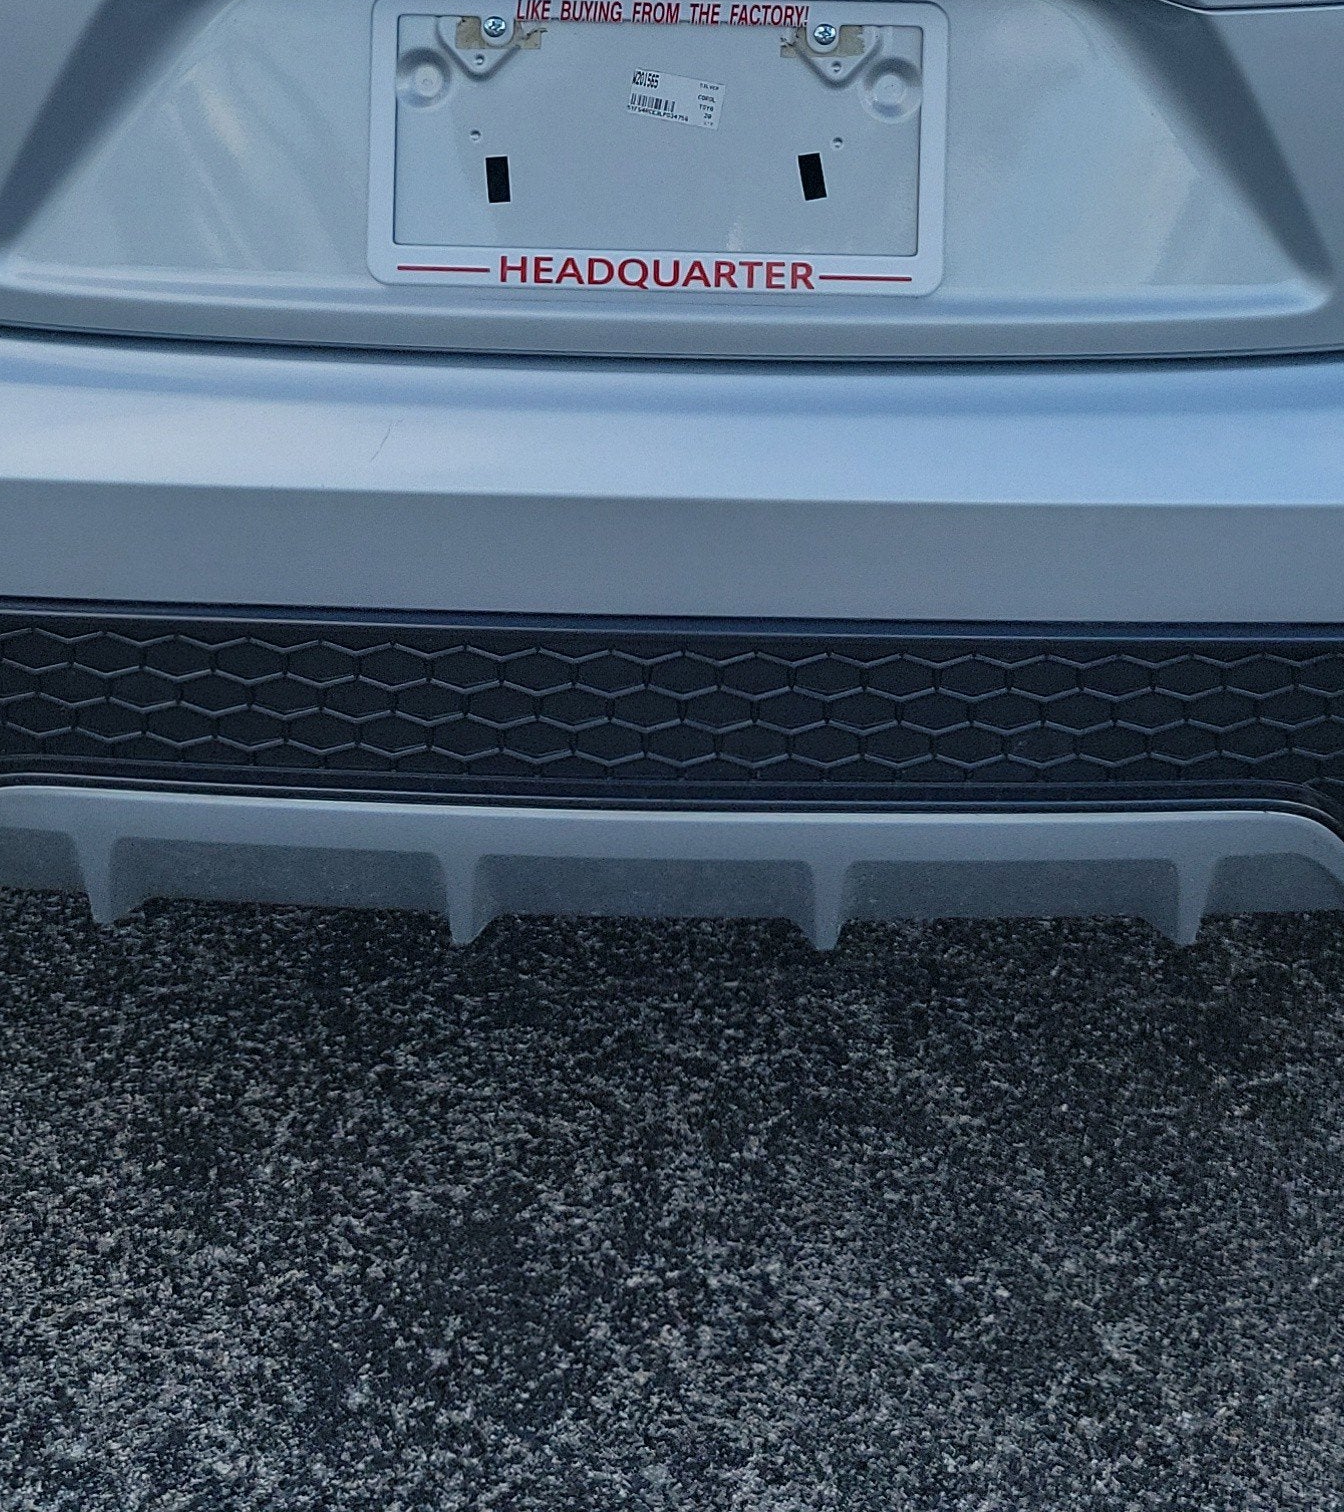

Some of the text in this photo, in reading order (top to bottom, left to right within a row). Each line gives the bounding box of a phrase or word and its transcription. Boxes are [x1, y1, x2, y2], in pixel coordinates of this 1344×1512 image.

[516, 0, 810, 26] LIKE BUYING FROM THE FACTORY!
[499, 255, 816, 290] HEADQUARTER
